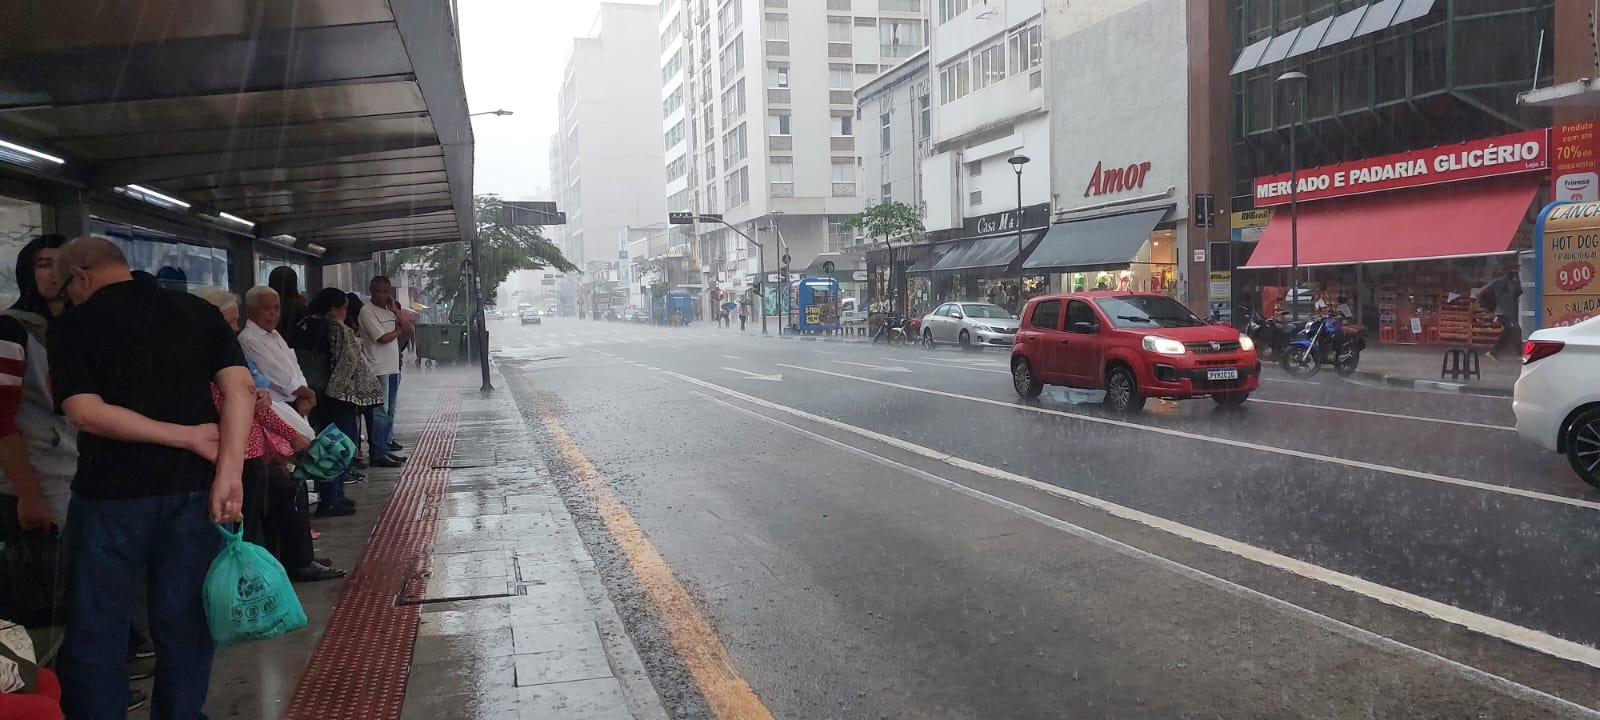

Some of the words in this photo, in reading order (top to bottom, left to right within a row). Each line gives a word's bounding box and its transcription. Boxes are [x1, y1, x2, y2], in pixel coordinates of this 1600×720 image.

[1562, 122, 1593, 134] Produto
[1562, 134, 1579, 143] com
[1556, 145, 1582, 160] 70%
[1084, 160, 1152, 198] Amor
[1257, 174, 1330, 199] MERCADO
[1334, 172, 1346, 187] E
[1349, 158, 1428, 186] PADARIA
[1433, 141, 1540, 173] GLICÉRIO
[977, 216, 996, 234] Casa
[1552, 235, 1574, 251] HOT
[1578, 233, 1599, 250] DOG
